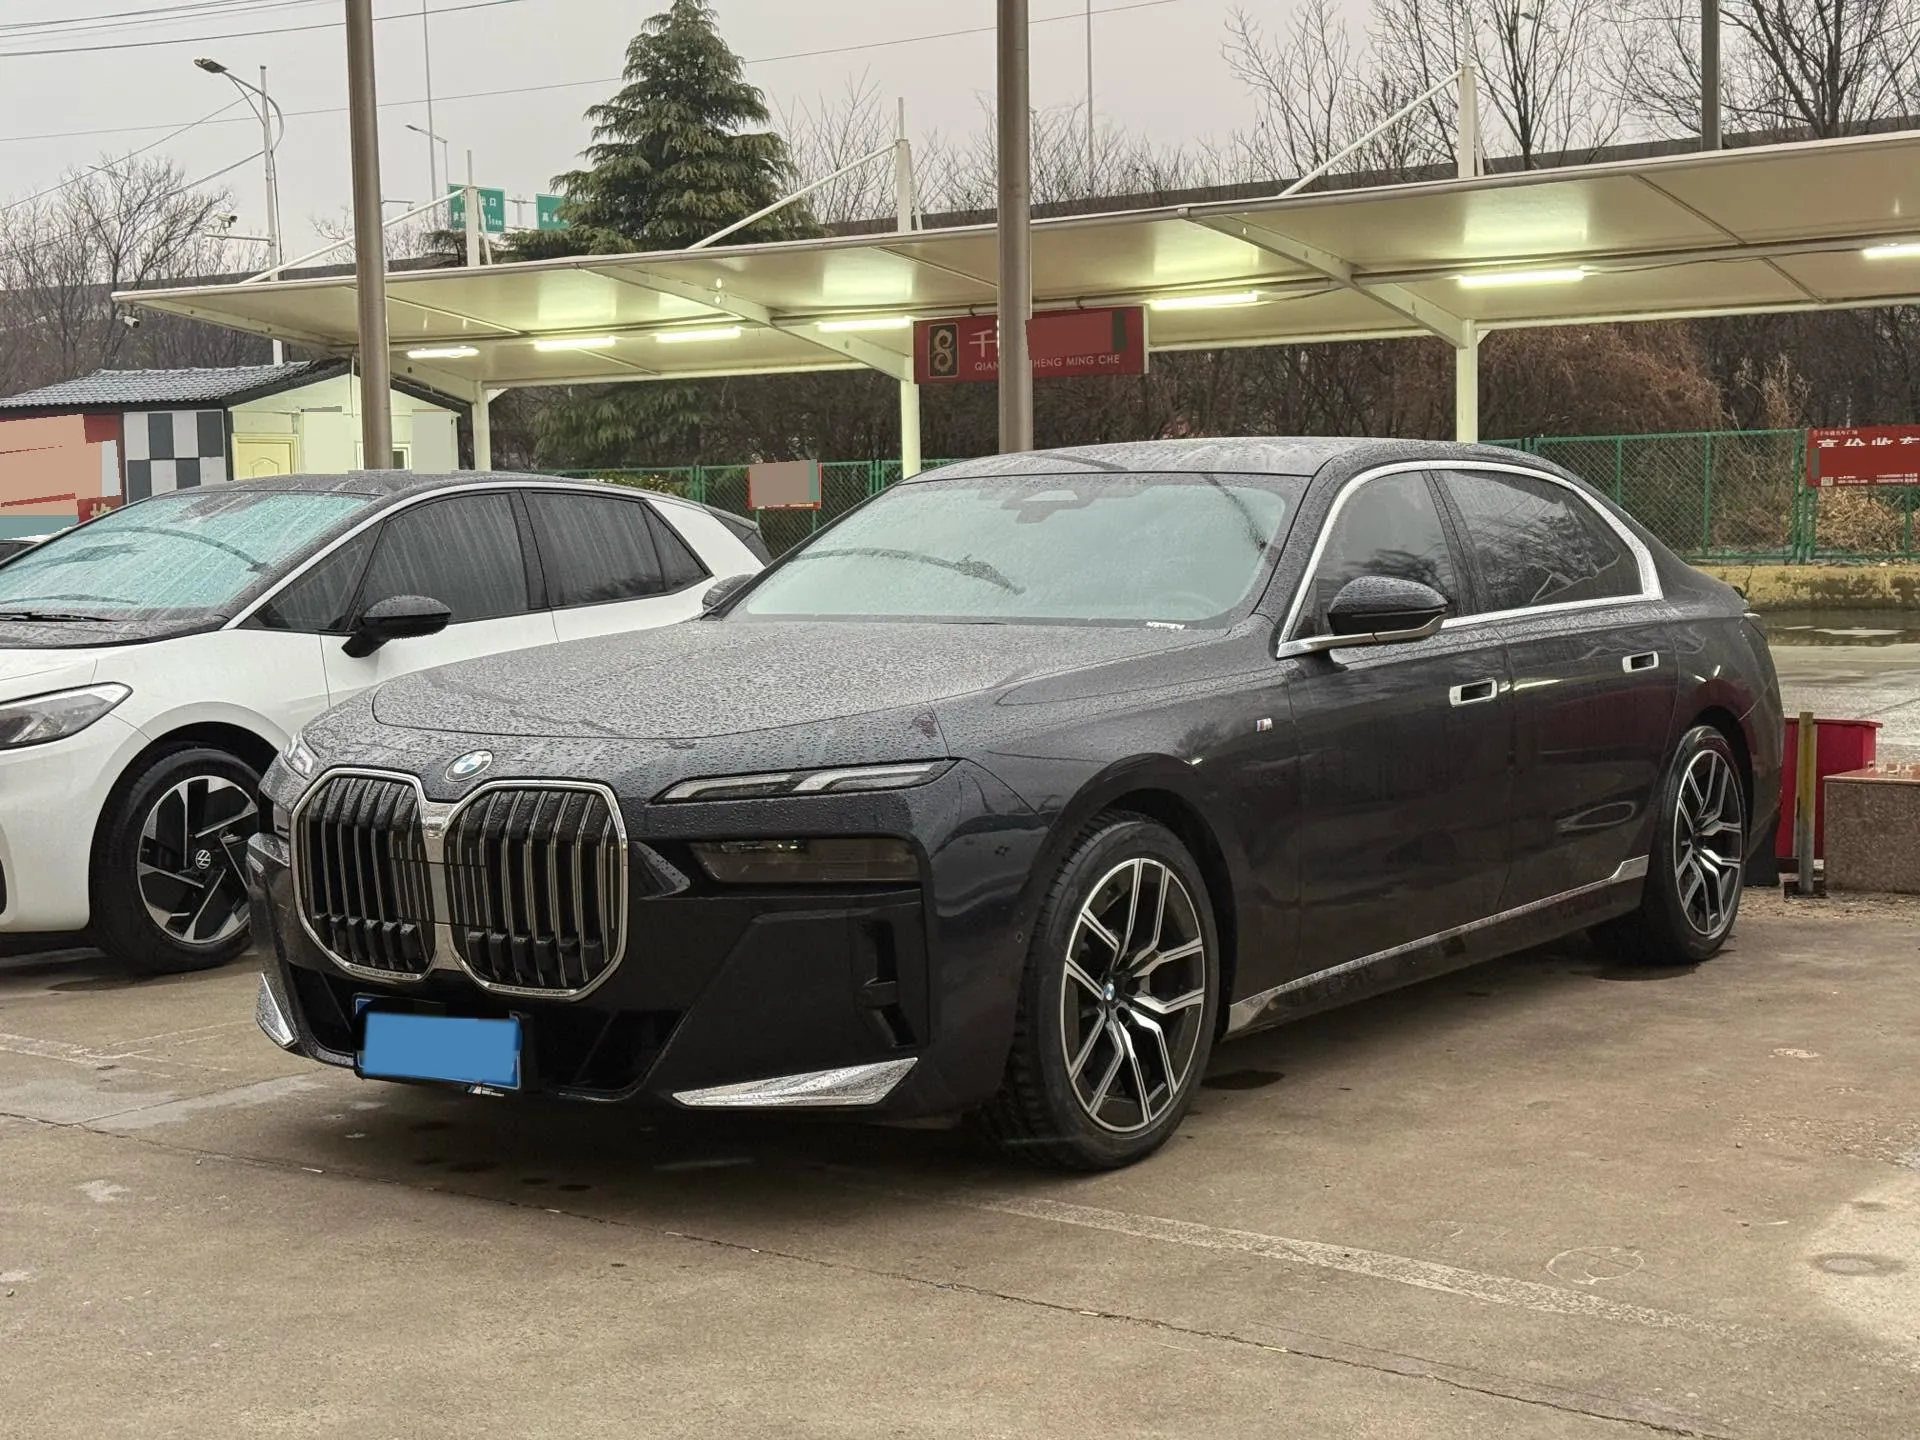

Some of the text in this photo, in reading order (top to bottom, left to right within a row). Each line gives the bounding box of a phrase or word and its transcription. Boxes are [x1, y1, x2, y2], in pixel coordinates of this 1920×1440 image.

[969, 329, 996, 357] 千
[1066, 356, 1094, 366] MING
[1097, 354, 1121, 364] CHE
